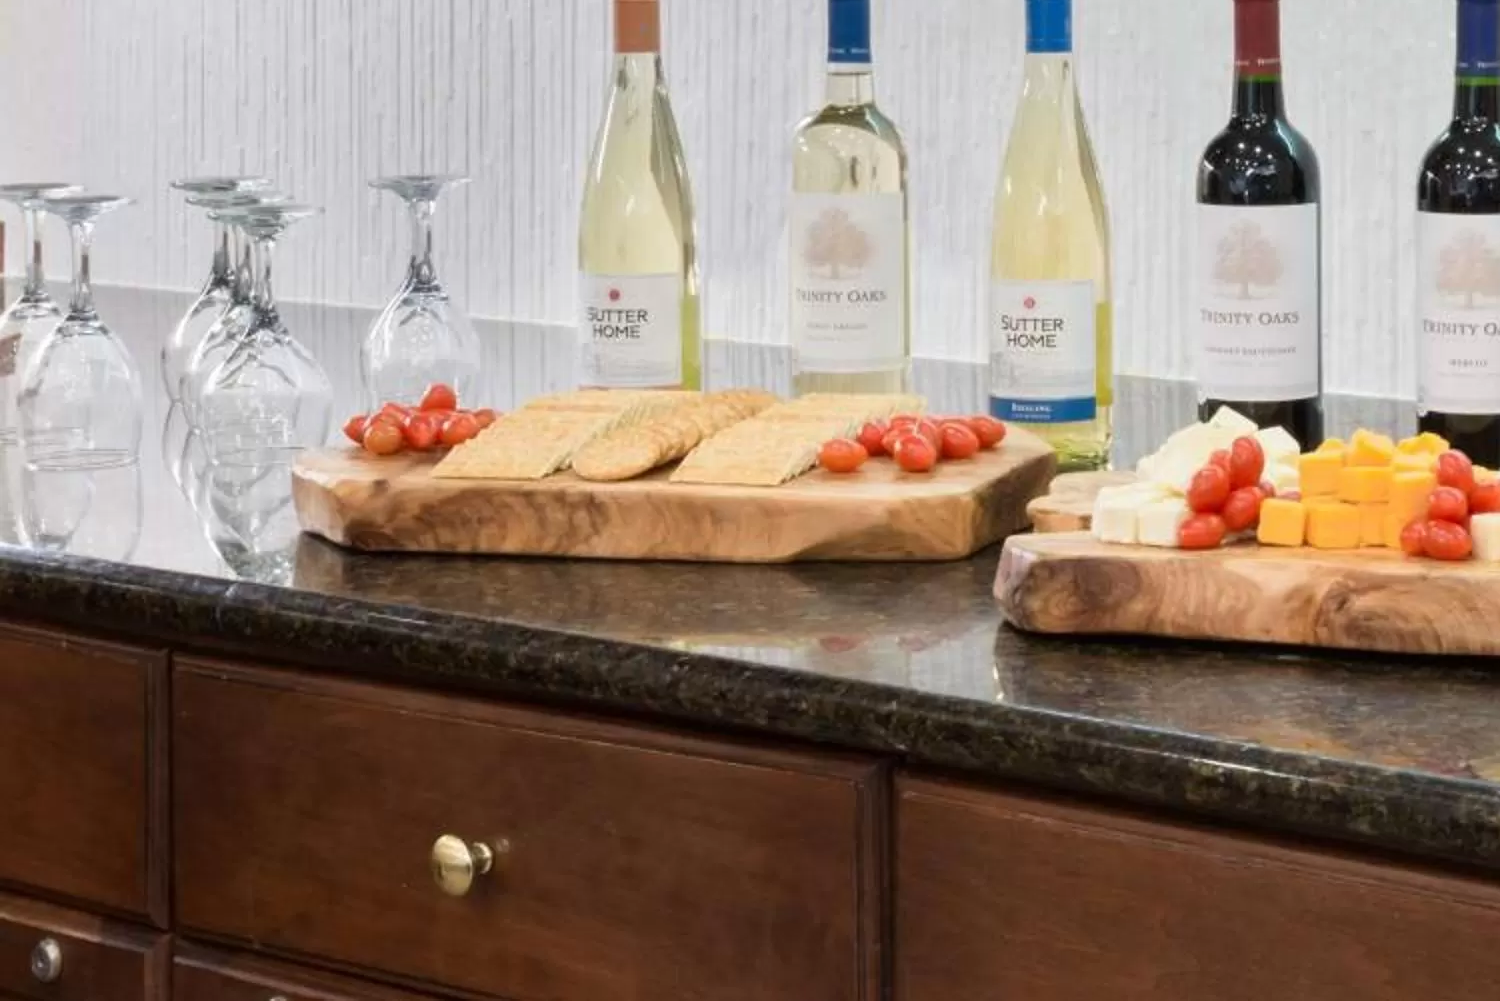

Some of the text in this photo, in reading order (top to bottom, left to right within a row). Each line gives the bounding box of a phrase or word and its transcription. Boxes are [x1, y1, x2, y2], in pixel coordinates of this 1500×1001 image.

[586, 306, 649, 323] SUTTER
[1200, 307, 1300, 325] TRINITY OAKS
[592, 324, 641, 339] HOME
[1000, 315, 1065, 332] SUTTER
[1422, 318, 1480, 336] TRINITY
[1007, 334, 1057, 348] HOME
